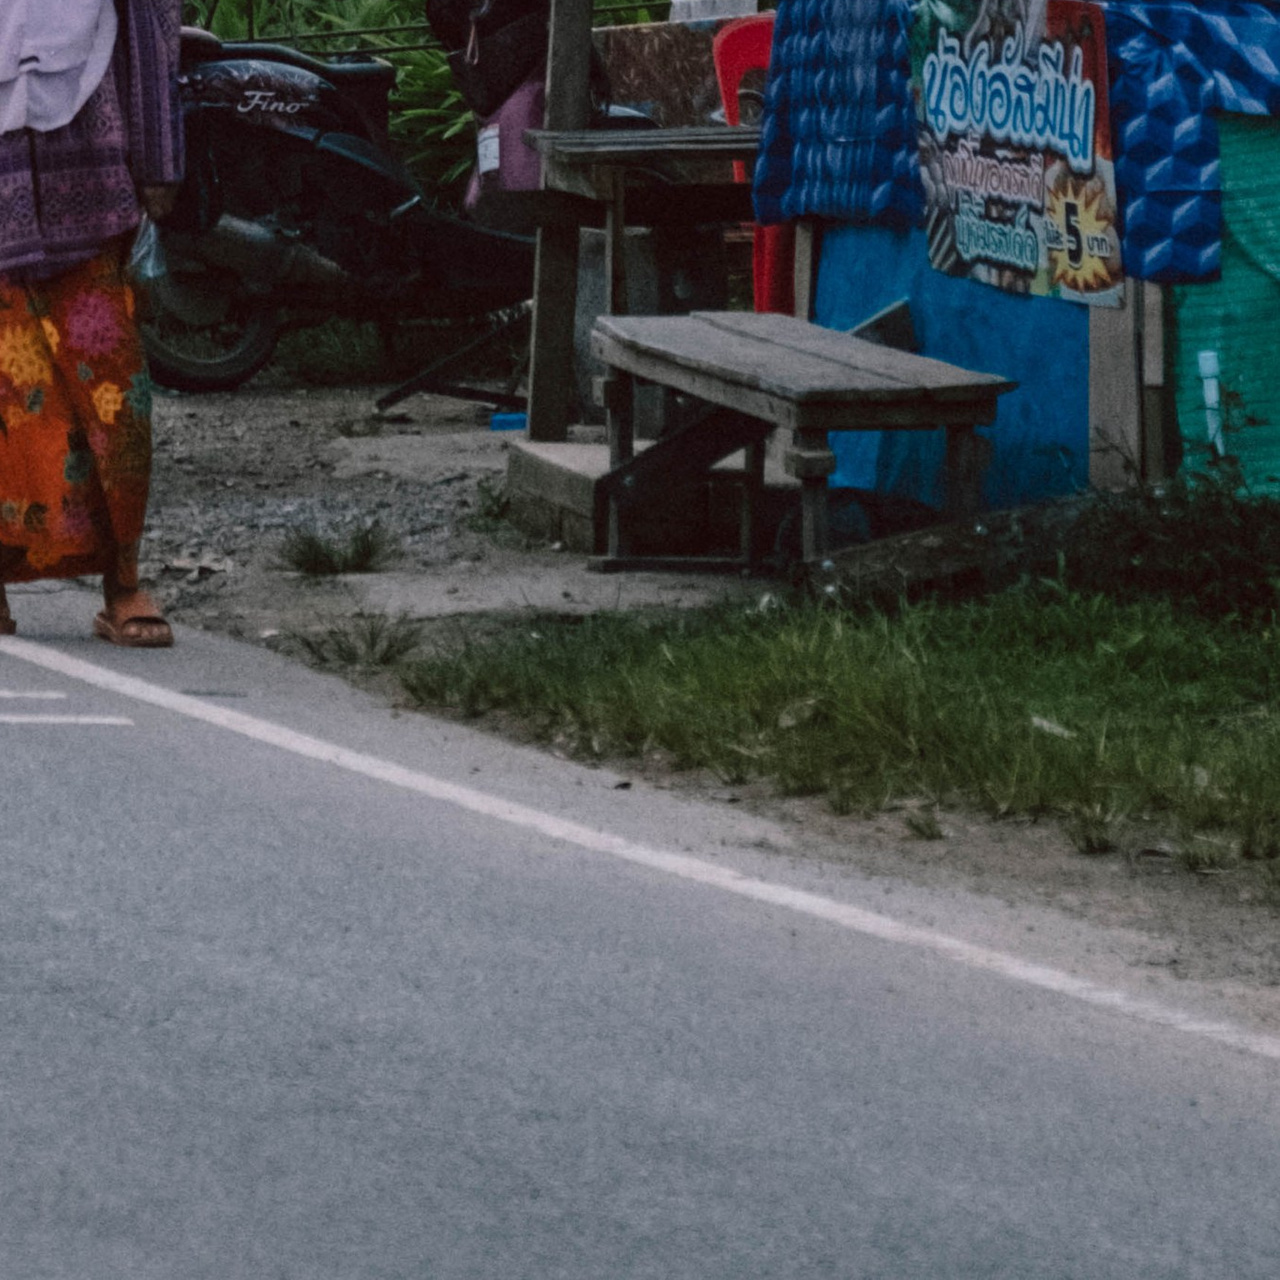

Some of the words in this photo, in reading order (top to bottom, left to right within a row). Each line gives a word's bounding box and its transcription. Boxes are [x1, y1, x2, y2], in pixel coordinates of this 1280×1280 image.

[237, 90, 310, 113] Fino
[924, 23, 1095, 172] น้องอัสมีน่า
[1064, 201, 1084, 265] 5
